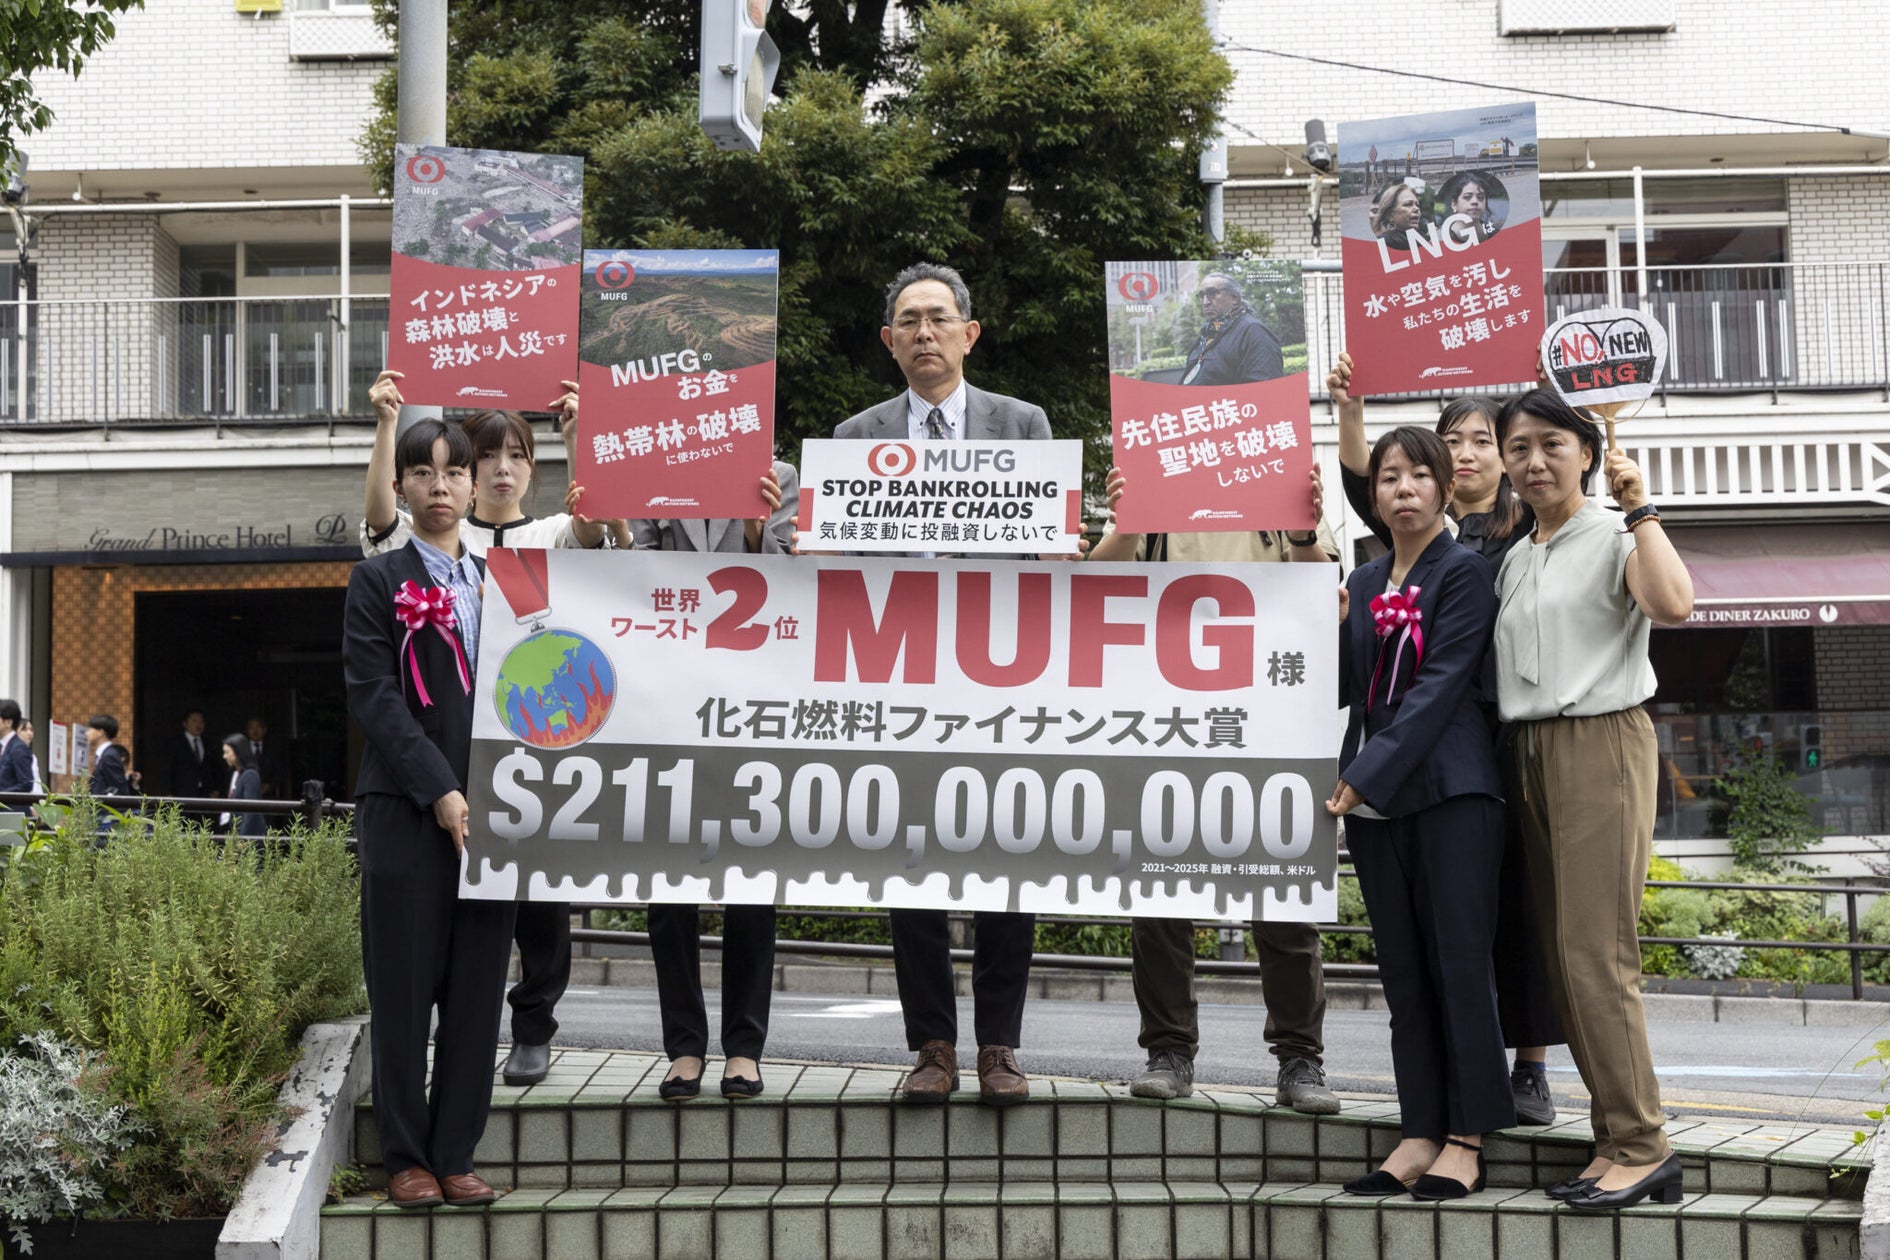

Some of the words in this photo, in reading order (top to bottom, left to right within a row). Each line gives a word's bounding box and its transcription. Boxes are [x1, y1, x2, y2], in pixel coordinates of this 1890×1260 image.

[412, 187, 438, 195] MUFG
[1376, 213, 1495, 274] LNGは
[410, 274, 557, 312] インドネシアの
[600, 292, 628, 301] MUFG
[1363, 258, 1512, 319] 水や空気を汚し
[1126, 304, 1153, 313] MUFG
[1402, 283, 1522, 331] 私たちの生活を
[405, 306, 520, 344] 森林破壊と
[1439, 308, 1531, 351] 破壊します
[429, 330, 567, 370] 洪水は人災です
[1608, 331, 1649, 357] NEW
[610, 349, 713, 388] MUFGの
[677, 368, 738, 401] お金を
[1571, 363, 1638, 390] LNG
[592, 403, 762, 465] 熱帯林の破壊
[1121, 398, 1258, 450] 先住民族の
[666, 442, 734, 466] に使わないで
[923, 449, 1016, 473] MUFG
[1157, 420, 1299, 478] 聖地を破壊
[822, 479, 882, 497] STOP
[888, 480, 1058, 498] BANKROLLING
[1216, 458, 1285, 488] しないで
[846, 500, 947, 519] CLIMATE
[951, 501, 1033, 520] CHAOS
[84, 526, 156, 550] Grand
[162, 527, 230, 549] Prince
[236, 524, 291, 549] Hotel
[819, 521, 1058, 542] 気候変動に投融資しないで
[651, 588, 701, 613] 世界
[1709, 610, 1751, 622] DINER
[1753, 608, 1810, 621] ZAKURO
[610, 617, 698, 640] ワースト
[814, 569, 1255, 692] MUFG
[1267, 651, 1306, 687] 様
[696, 697, 1249, 749] 化石燃料ファイナンス大賞
[488, 747, 1314, 873] $211,300,000,000
